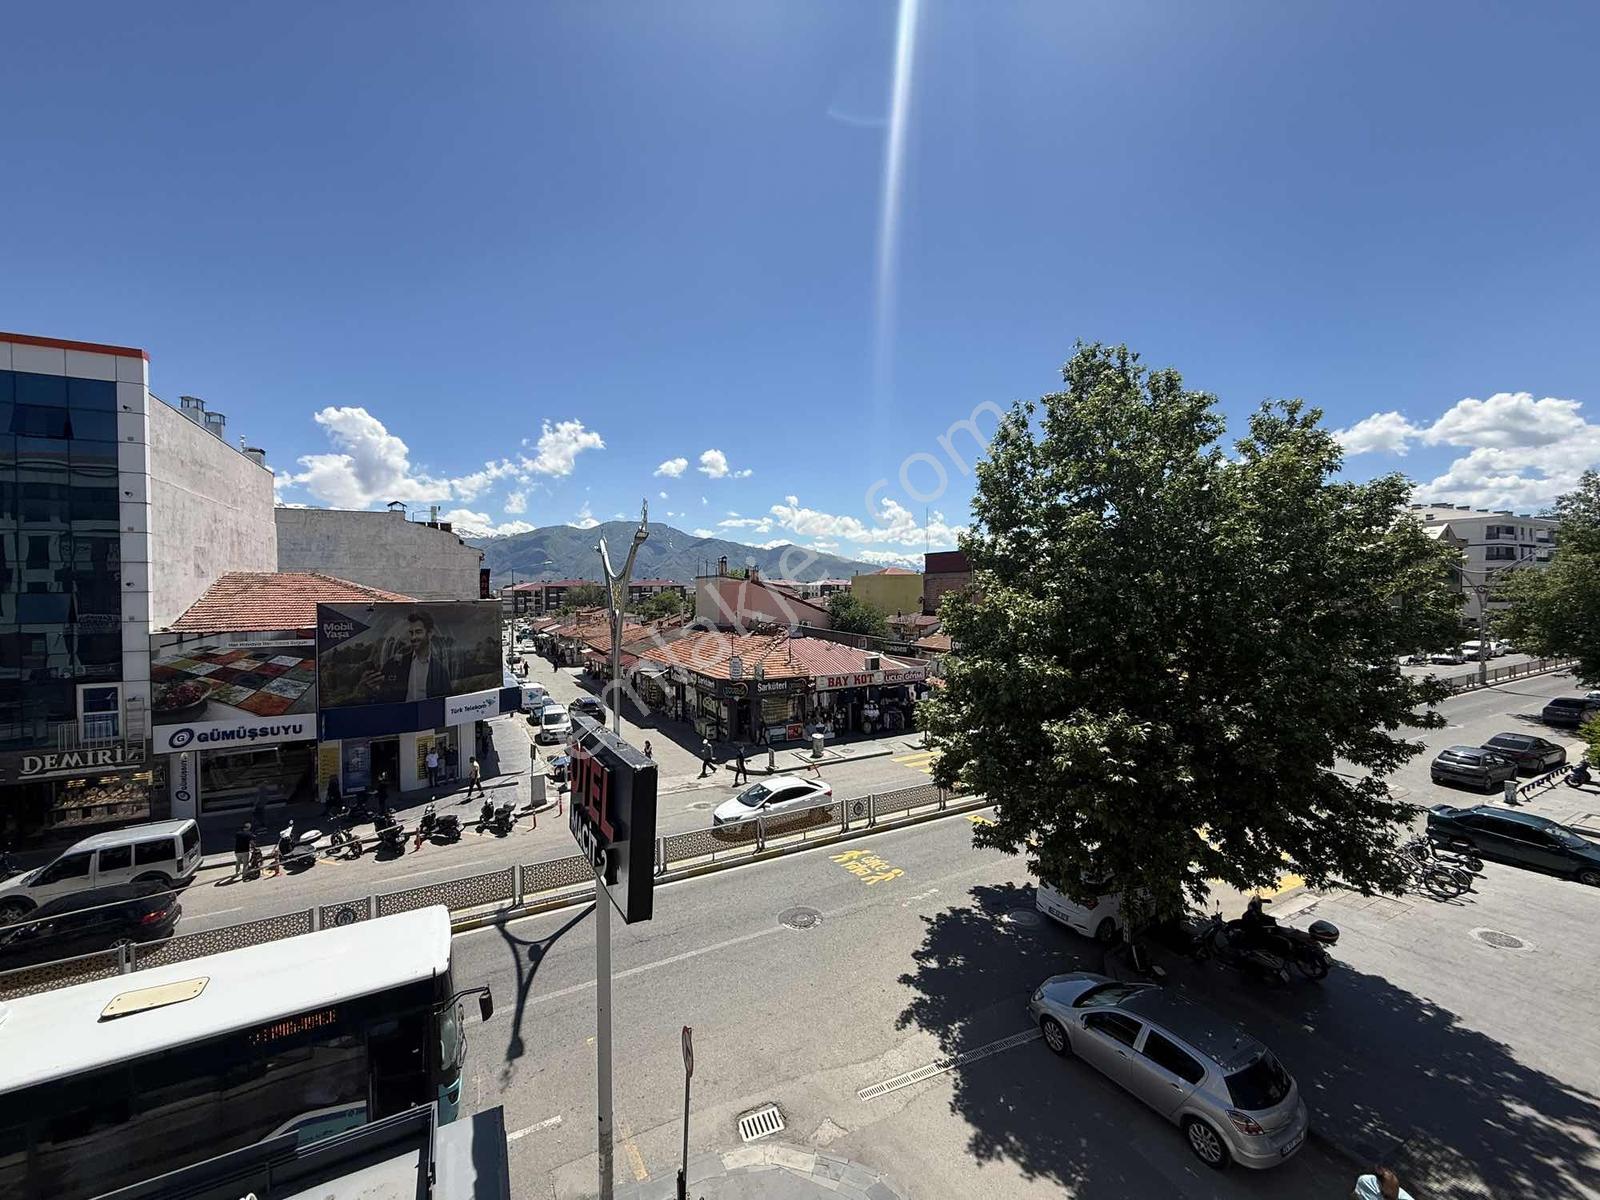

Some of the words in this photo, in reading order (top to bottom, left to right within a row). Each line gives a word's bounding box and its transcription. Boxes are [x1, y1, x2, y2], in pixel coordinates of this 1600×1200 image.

[323, 622, 354, 631] Mobil
[324, 630, 350, 640] Yaşa
[827, 675, 849, 688] BAY
[853, 673, 875, 685] KOT
[450, 707, 463, 715] Türk
[464, 703, 487, 712] Telekom
[196, 724, 303, 743] GÜMÜŞSUYU
